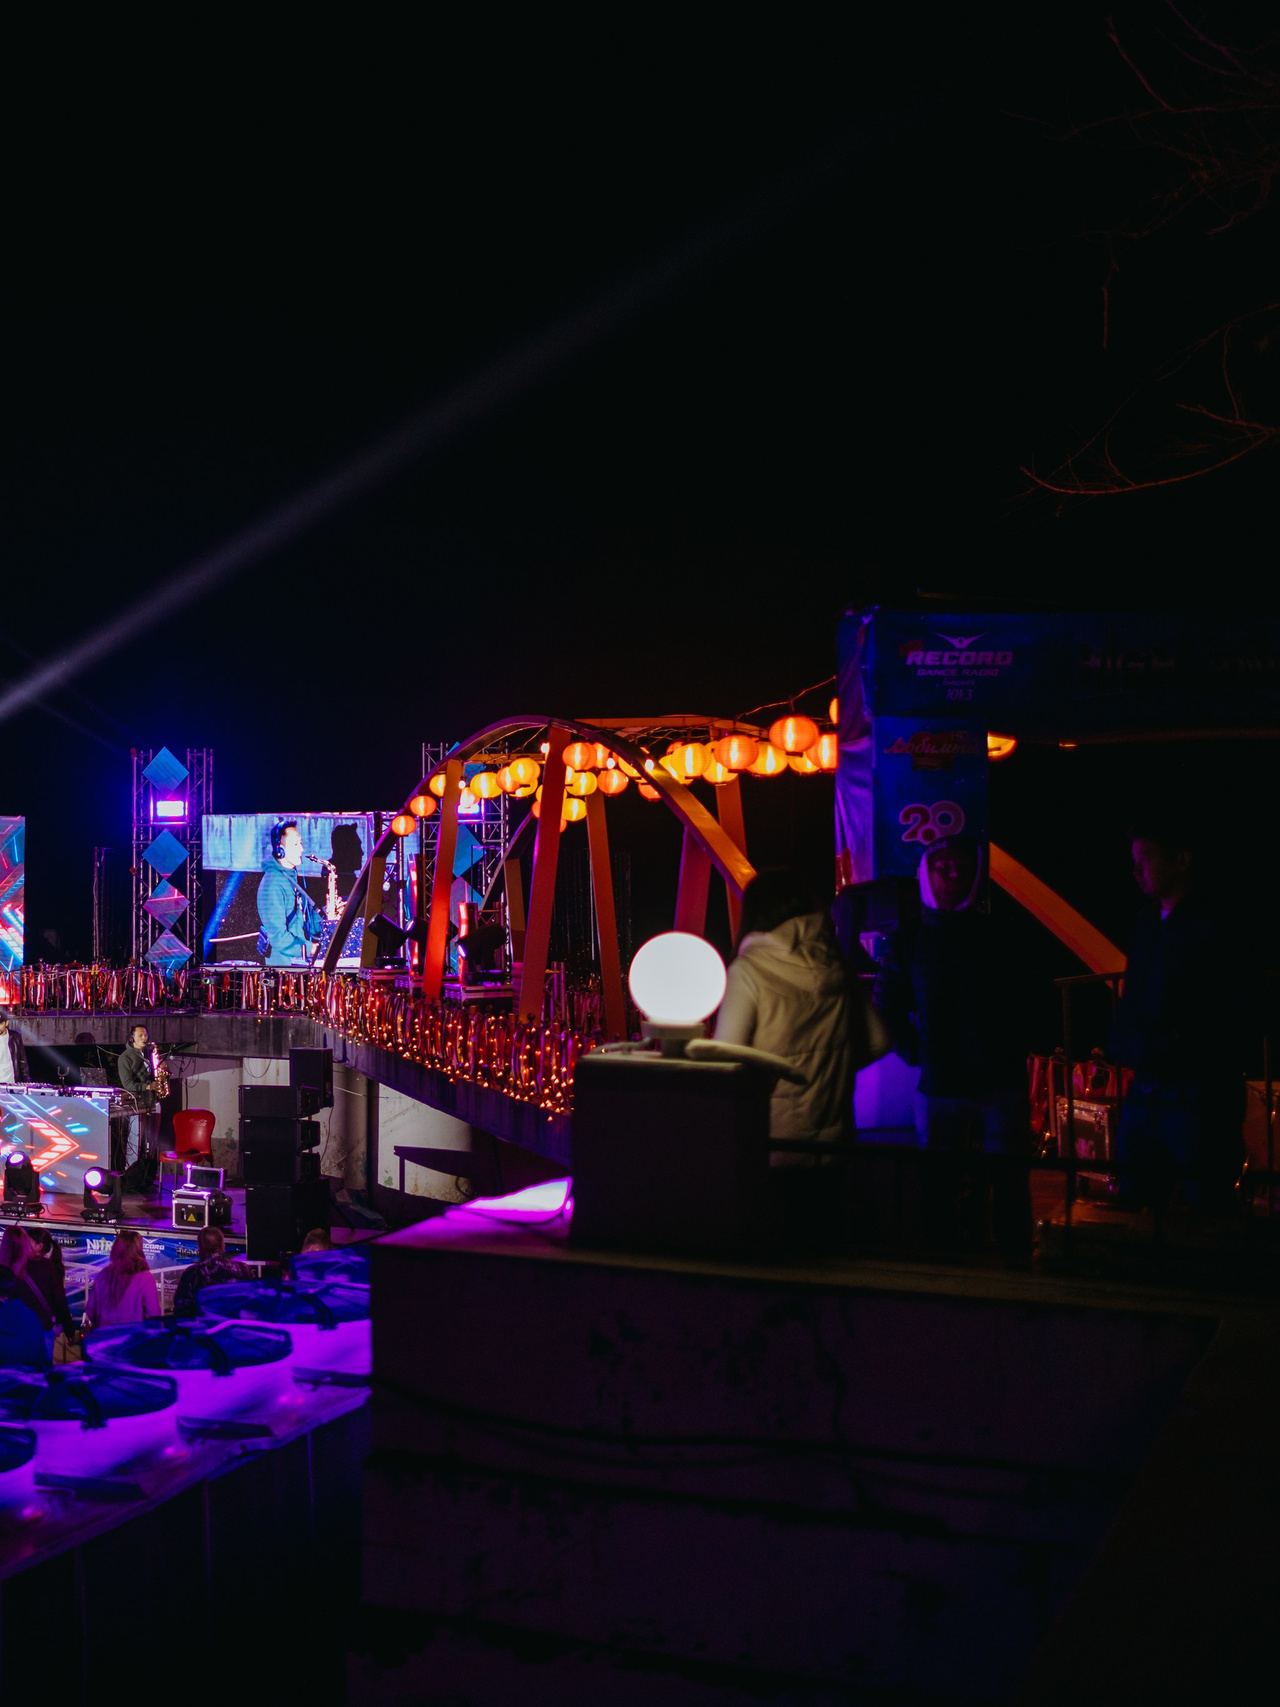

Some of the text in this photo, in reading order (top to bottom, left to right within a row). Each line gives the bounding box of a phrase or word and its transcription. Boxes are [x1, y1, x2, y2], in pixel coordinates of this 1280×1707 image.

[905, 650, 1014, 667] RECORD
[916, 668, 999, 676] DANCE RADIO
[86, 1238, 114, 1251] NITR
